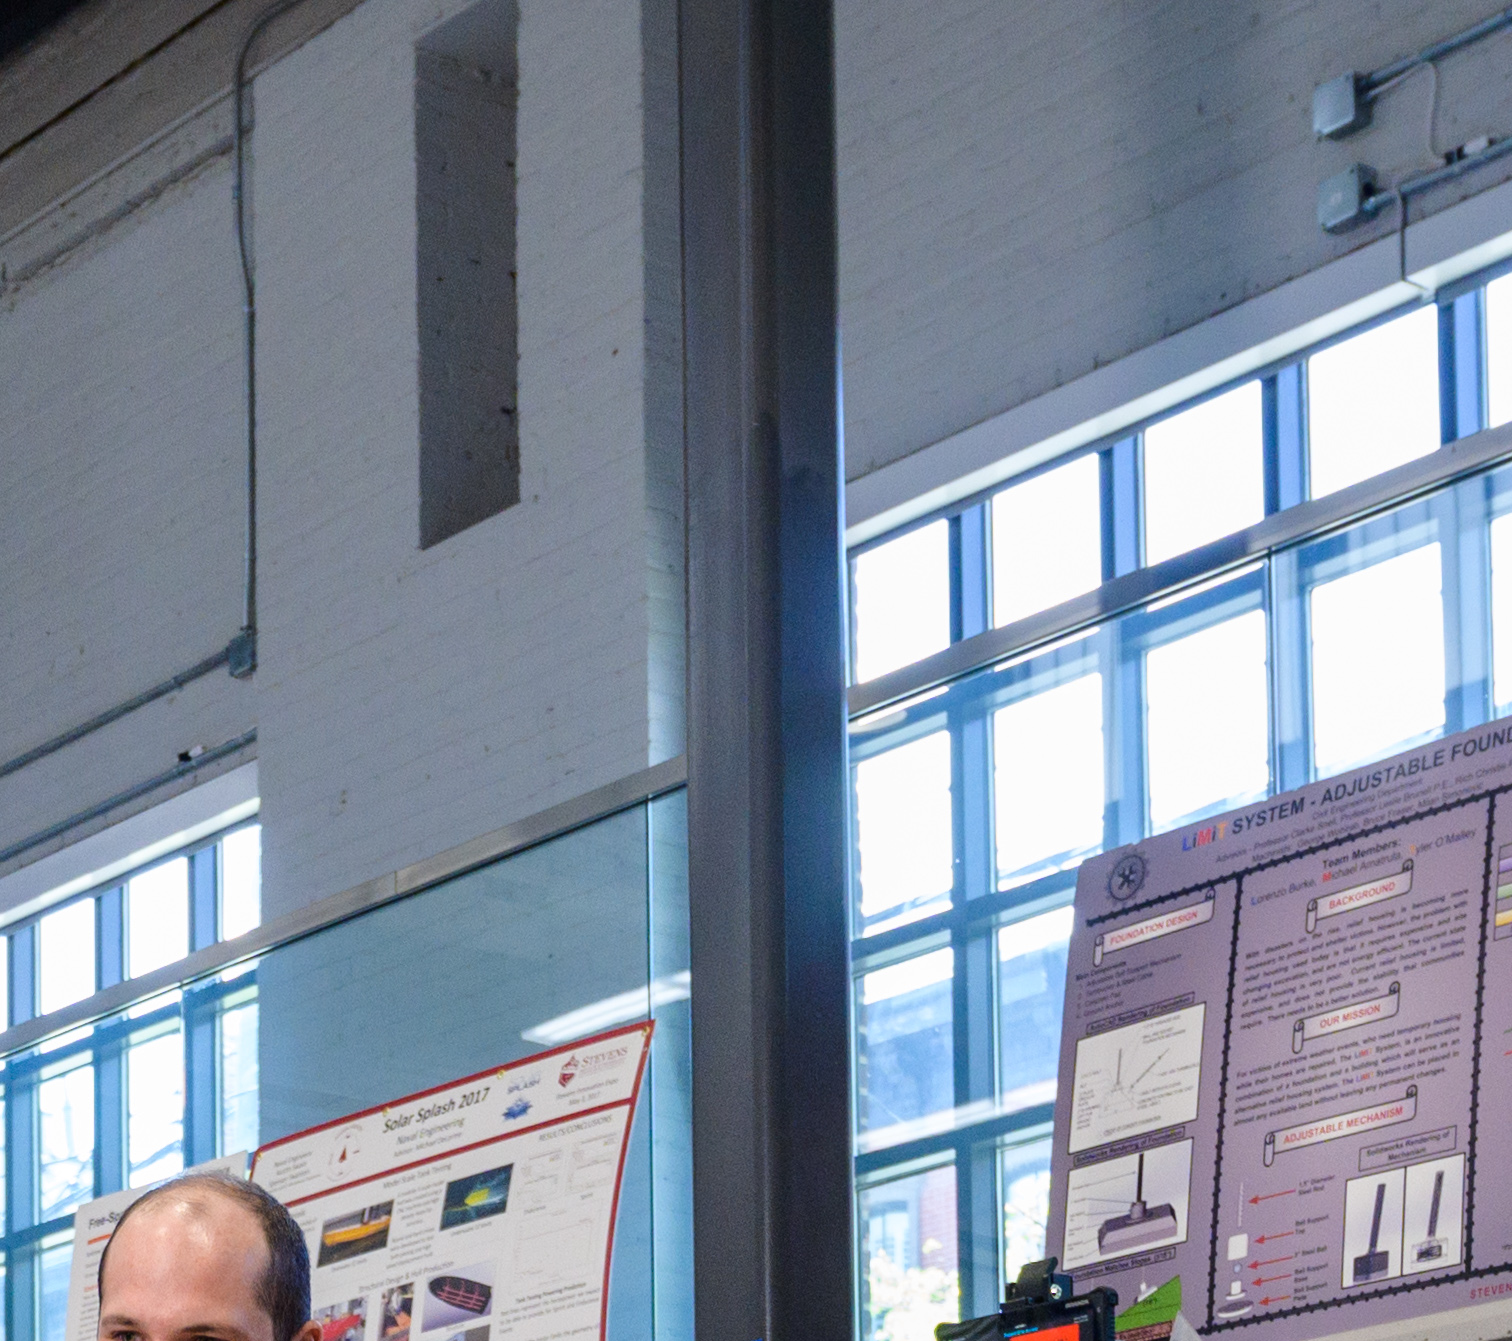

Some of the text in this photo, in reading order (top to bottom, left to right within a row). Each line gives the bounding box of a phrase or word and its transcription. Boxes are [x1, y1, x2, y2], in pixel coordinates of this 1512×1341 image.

[1182, 820, 1228, 852] LiMiT
[1232, 797, 1306, 835] SYSTEM
[1320, 749, 1446, 807] ADJUSTABLE
[1322, 835, 1401, 870] Team Members:
[1250, 885, 1286, 906] Lorenzo
[1321, 862, 1358, 883] Michael
[1409, 838, 1432, 858] Tyler
[1328, 880, 1396, 910] BACKGROUND
[1109, 909, 1198, 946] FOUNDATION DESIGN
[1319, 1003, 1381, 1029] OUR MISSION
[382, 1085, 490, 1134] Solar Splash 2017
[1282, 1105, 1403, 1145] ADJUSTABLE MECHANISM
[395, 1129, 417, 1146] Naval
[418, 1115, 465, 1141] Engineering
